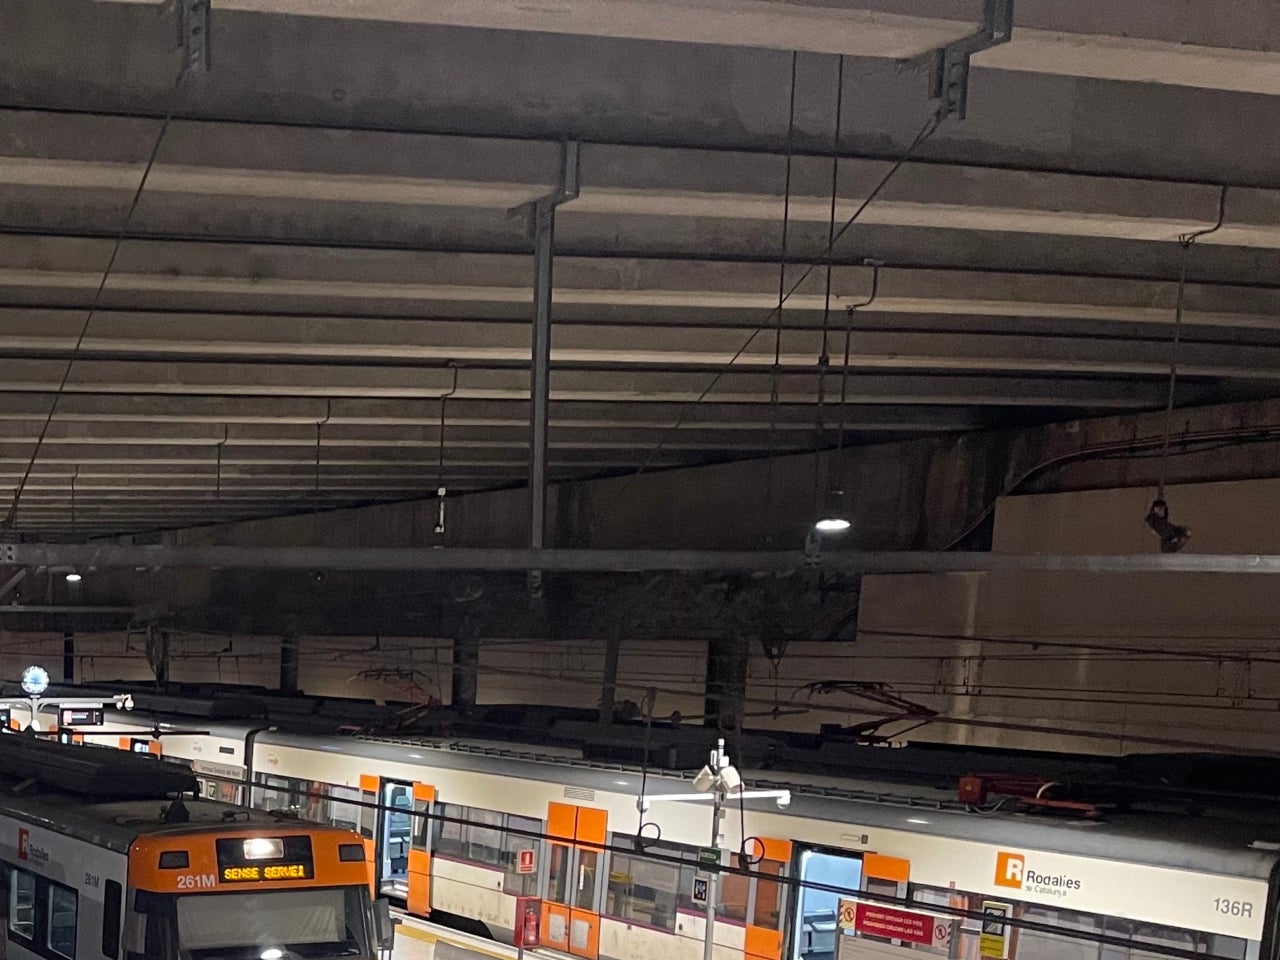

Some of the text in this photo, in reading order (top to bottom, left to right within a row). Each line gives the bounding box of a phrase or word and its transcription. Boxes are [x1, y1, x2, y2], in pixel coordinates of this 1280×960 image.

[224, 867, 259, 880] SENSE
[1005, 858, 1024, 881] R
[176, 874, 216, 889] 261M
[1026, 870, 1081, 890] Rodalies
[1213, 897, 1254, 918] 136R
